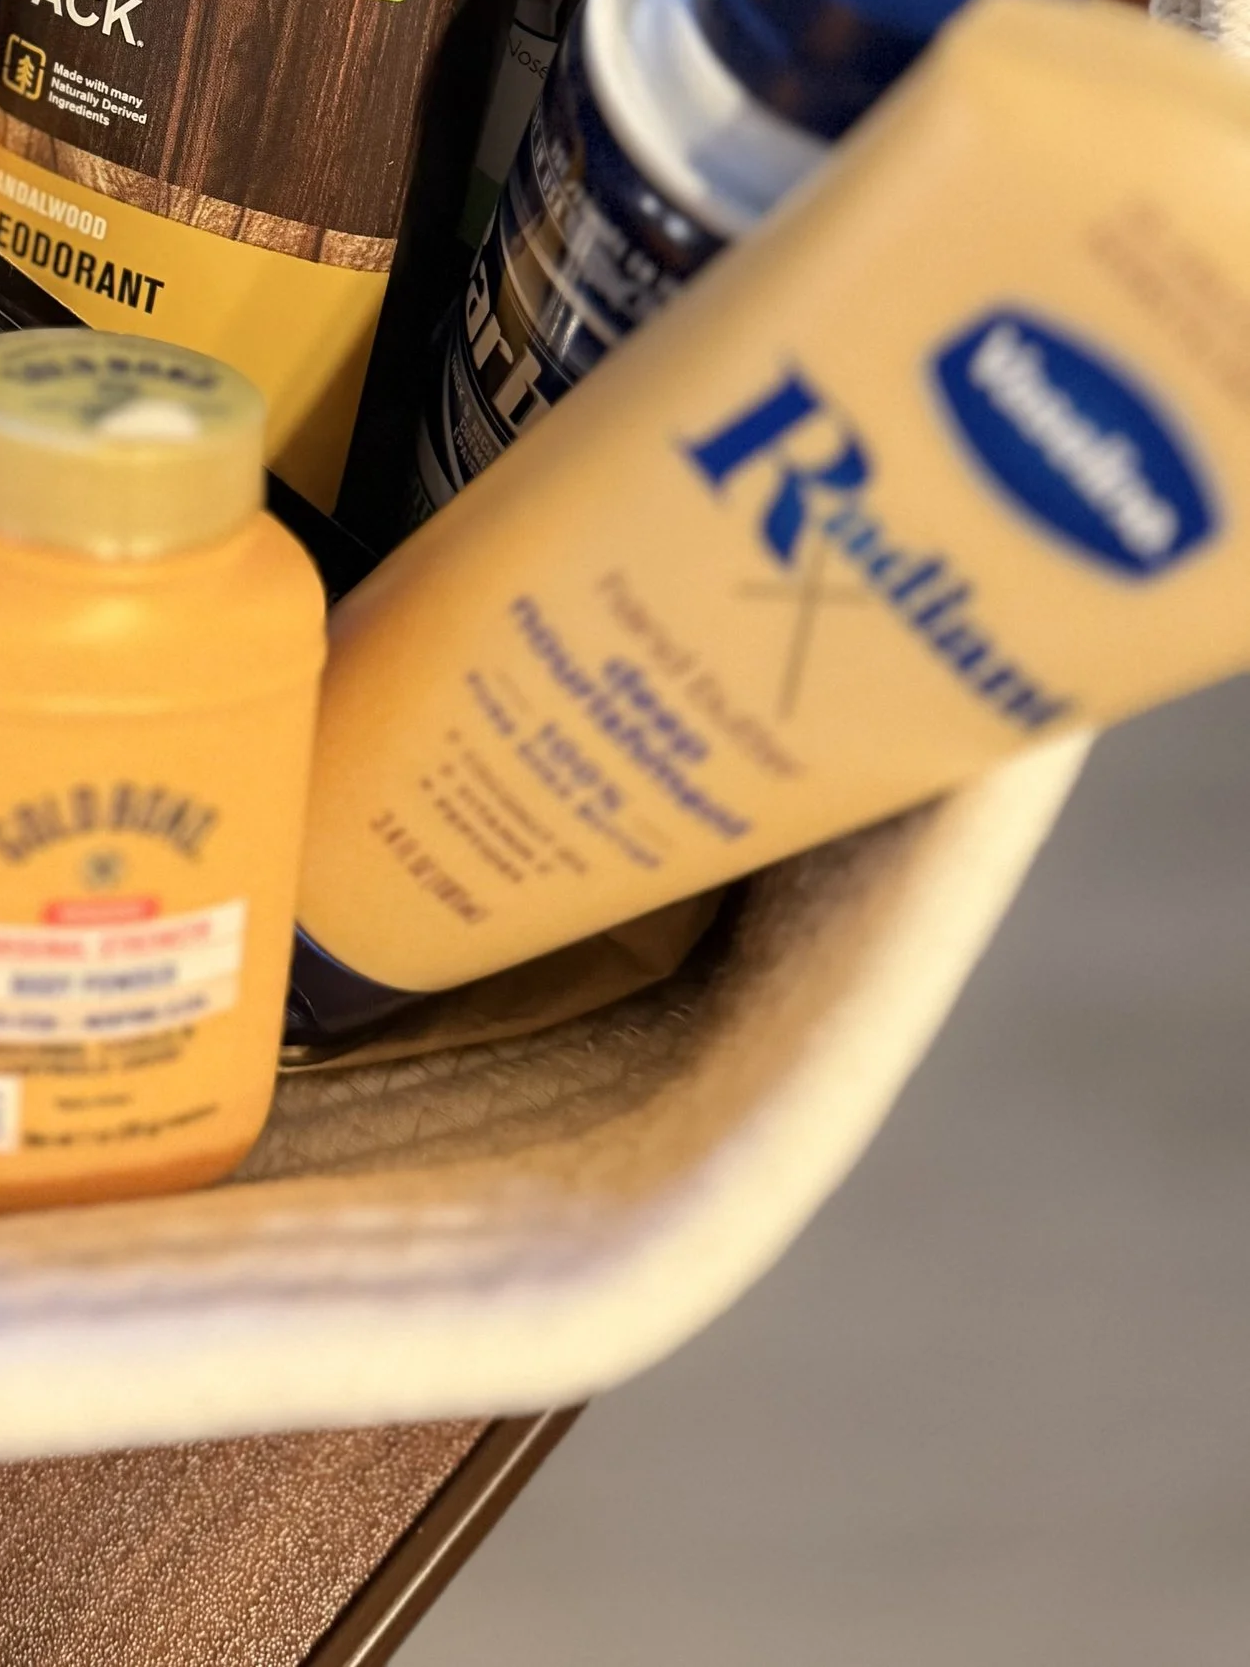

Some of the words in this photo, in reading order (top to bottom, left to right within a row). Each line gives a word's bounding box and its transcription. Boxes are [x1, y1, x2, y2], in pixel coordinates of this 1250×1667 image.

[48, 90, 111, 126] Ingredients
[50, 76, 100, 108] Naturally
[101, 97, 148, 125] Derived
[53, 61, 84, 84] Made
[84, 77, 110, 94] with
[110, 87, 144, 109] many
[508, 593, 755, 845] nourishment
[599, 654, 715, 767] deep
